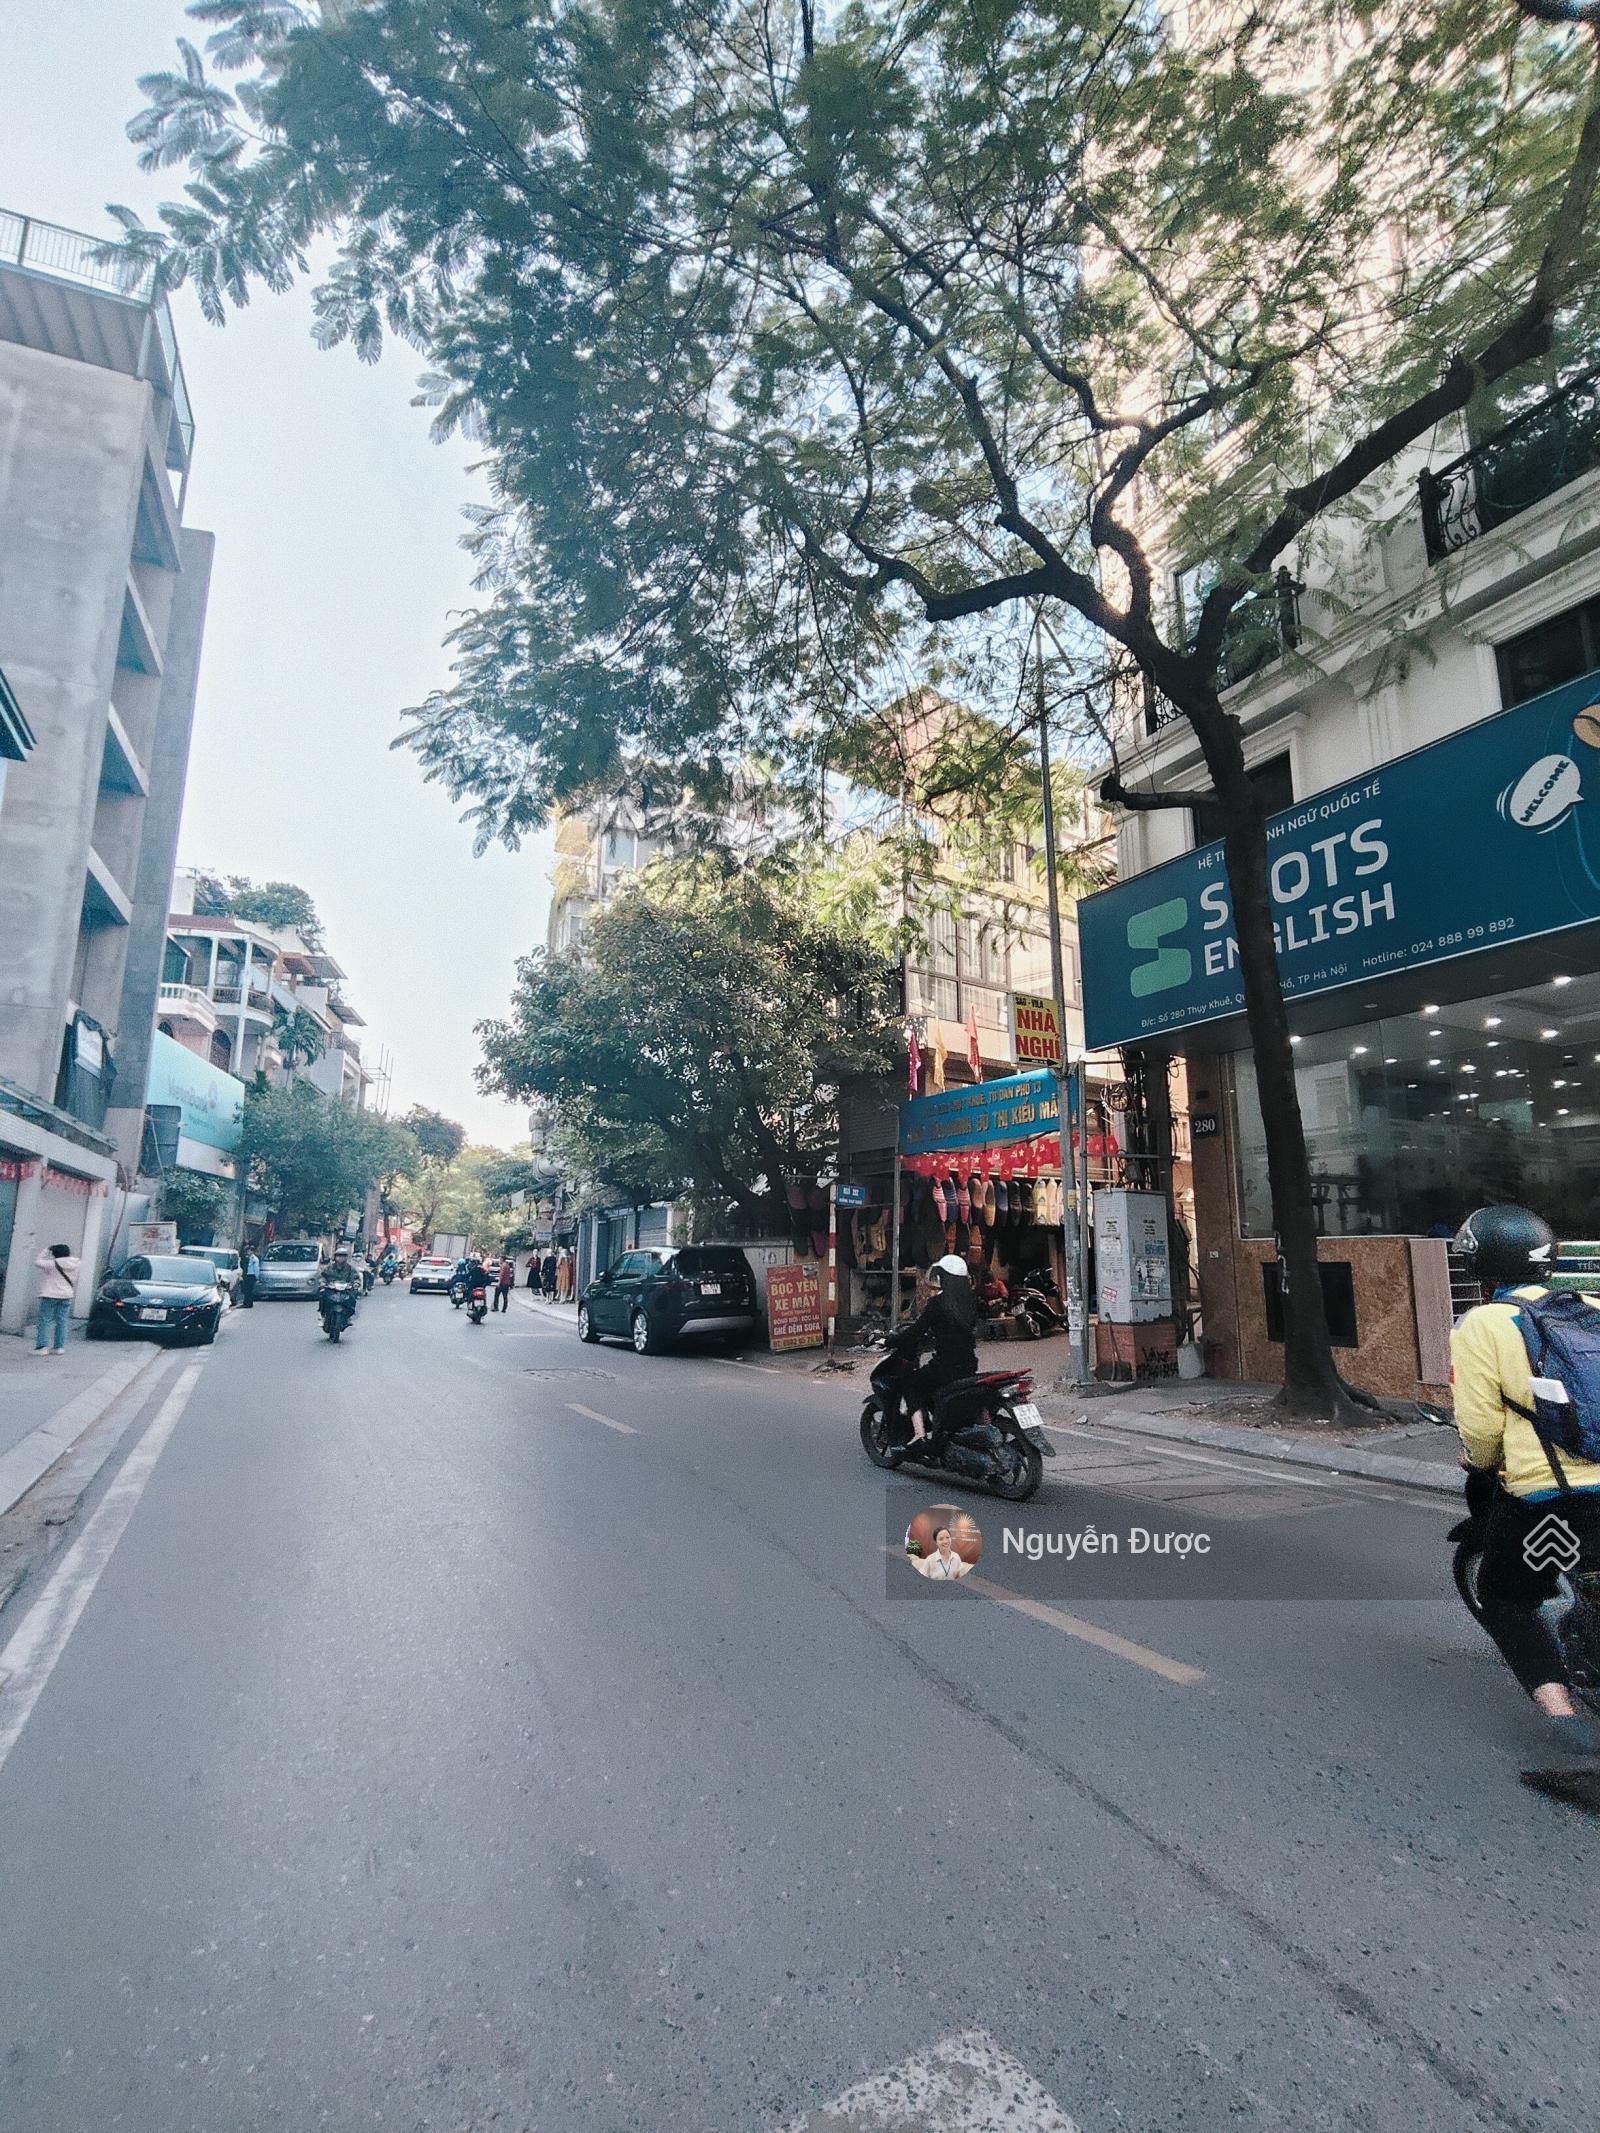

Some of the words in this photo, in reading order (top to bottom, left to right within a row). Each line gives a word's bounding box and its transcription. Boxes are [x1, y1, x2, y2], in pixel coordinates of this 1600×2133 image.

[1520, 760, 1570, 822] WELCOME
[1198, 854, 1213, 869] HỆ
[1266, 824, 1285, 841] NH
[1288, 808, 1317, 832] NGỮ
[1320, 791, 1361, 819] QUỐC
[1363, 777, 1381, 799] TẾ
[1200, 818, 1389, 930] SOTS
[1158, 1009, 1168, 1023] Số
[1170, 1009, 1185, 1021] 280
[1297, 974, 1310, 985] TP
[1313, 969, 1328, 981] Hà
[1330, 962, 1348, 976] Nội
[1363, 947, 1408, 968] Hotline:
[1411, 940, 1434, 954] 024
[1438, 932, 1463, 947] 888
[1467, 926, 1484, 939] 99
[1489, 917, 1515, 933] 892
[1017, 1008, 1057, 1033] NHÀ
[1015, 1033, 1061, 1060] NGHỈ
[1194, 1118, 1216, 1133] 280
[770, 1282, 794, 1298] BỌC
[775, 1299, 789, 1312] XE
[792, 1293, 817, 1309] MÁY
[804, 1322, 821, 1332] SOFA
